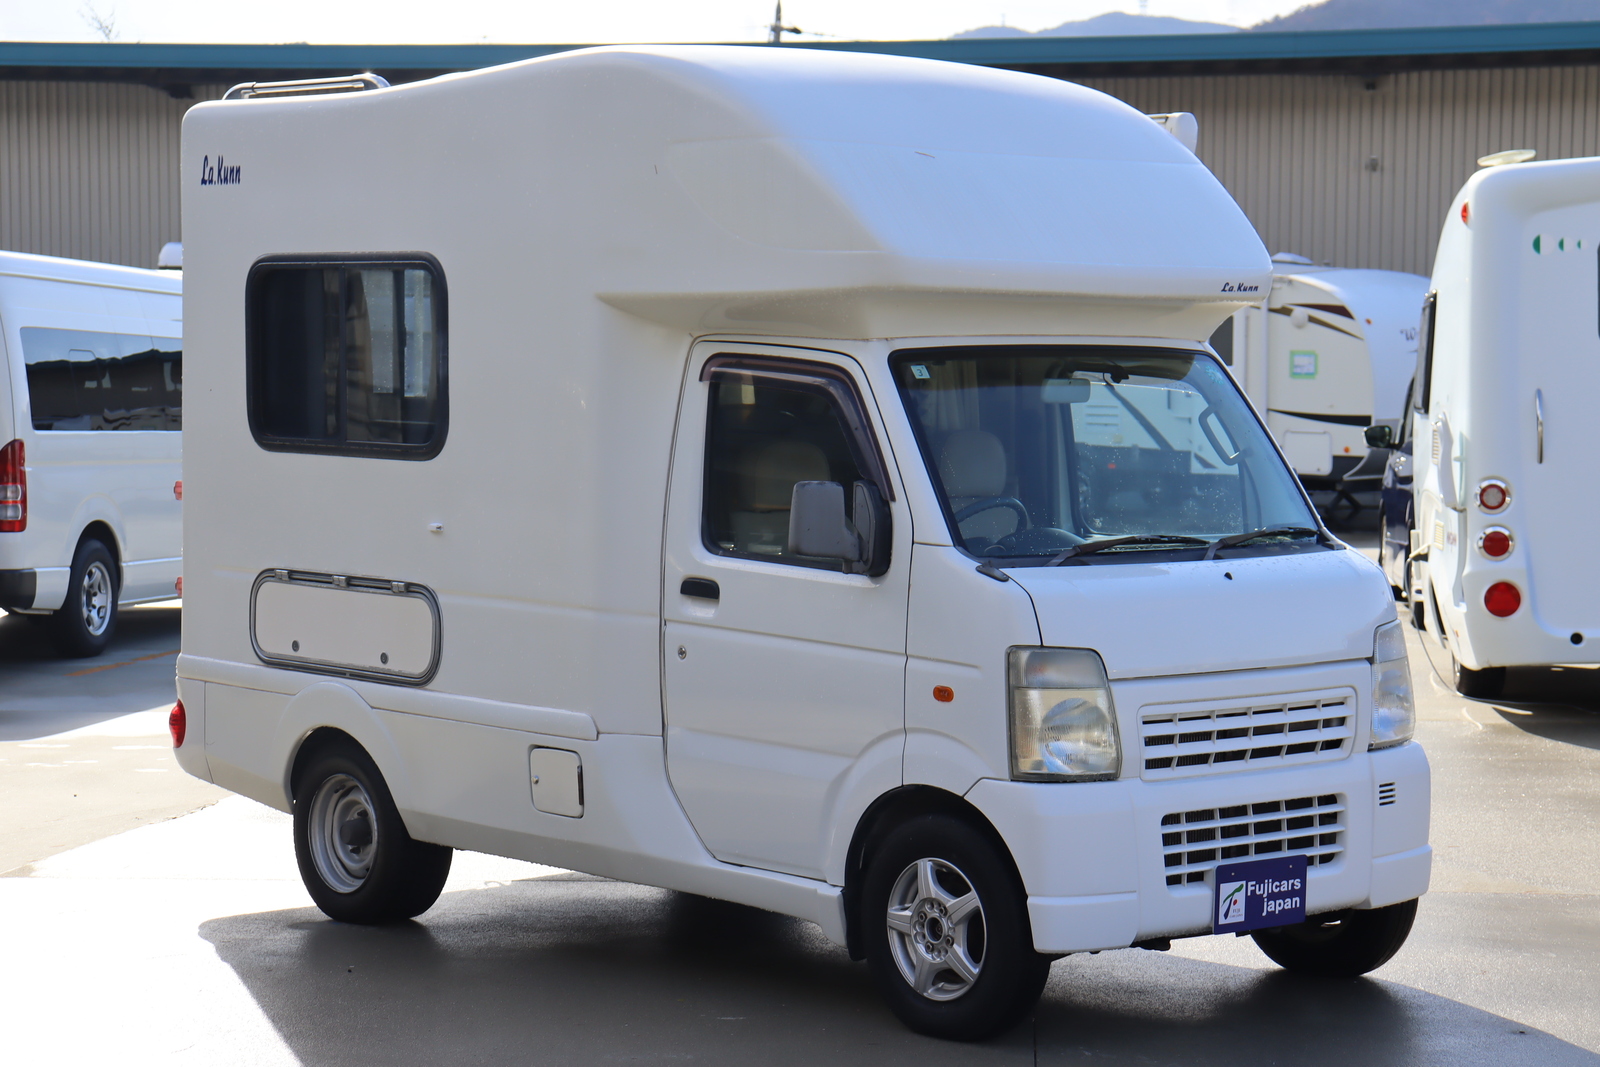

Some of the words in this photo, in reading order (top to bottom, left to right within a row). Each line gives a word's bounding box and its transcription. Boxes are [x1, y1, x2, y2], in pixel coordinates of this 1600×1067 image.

[201, 154, 241, 185] La.Kunn
[1221, 282, 1259, 292] La.Kunn
[1247, 878, 1301, 898] Fujicars
[1262, 897, 1300, 916] japan
